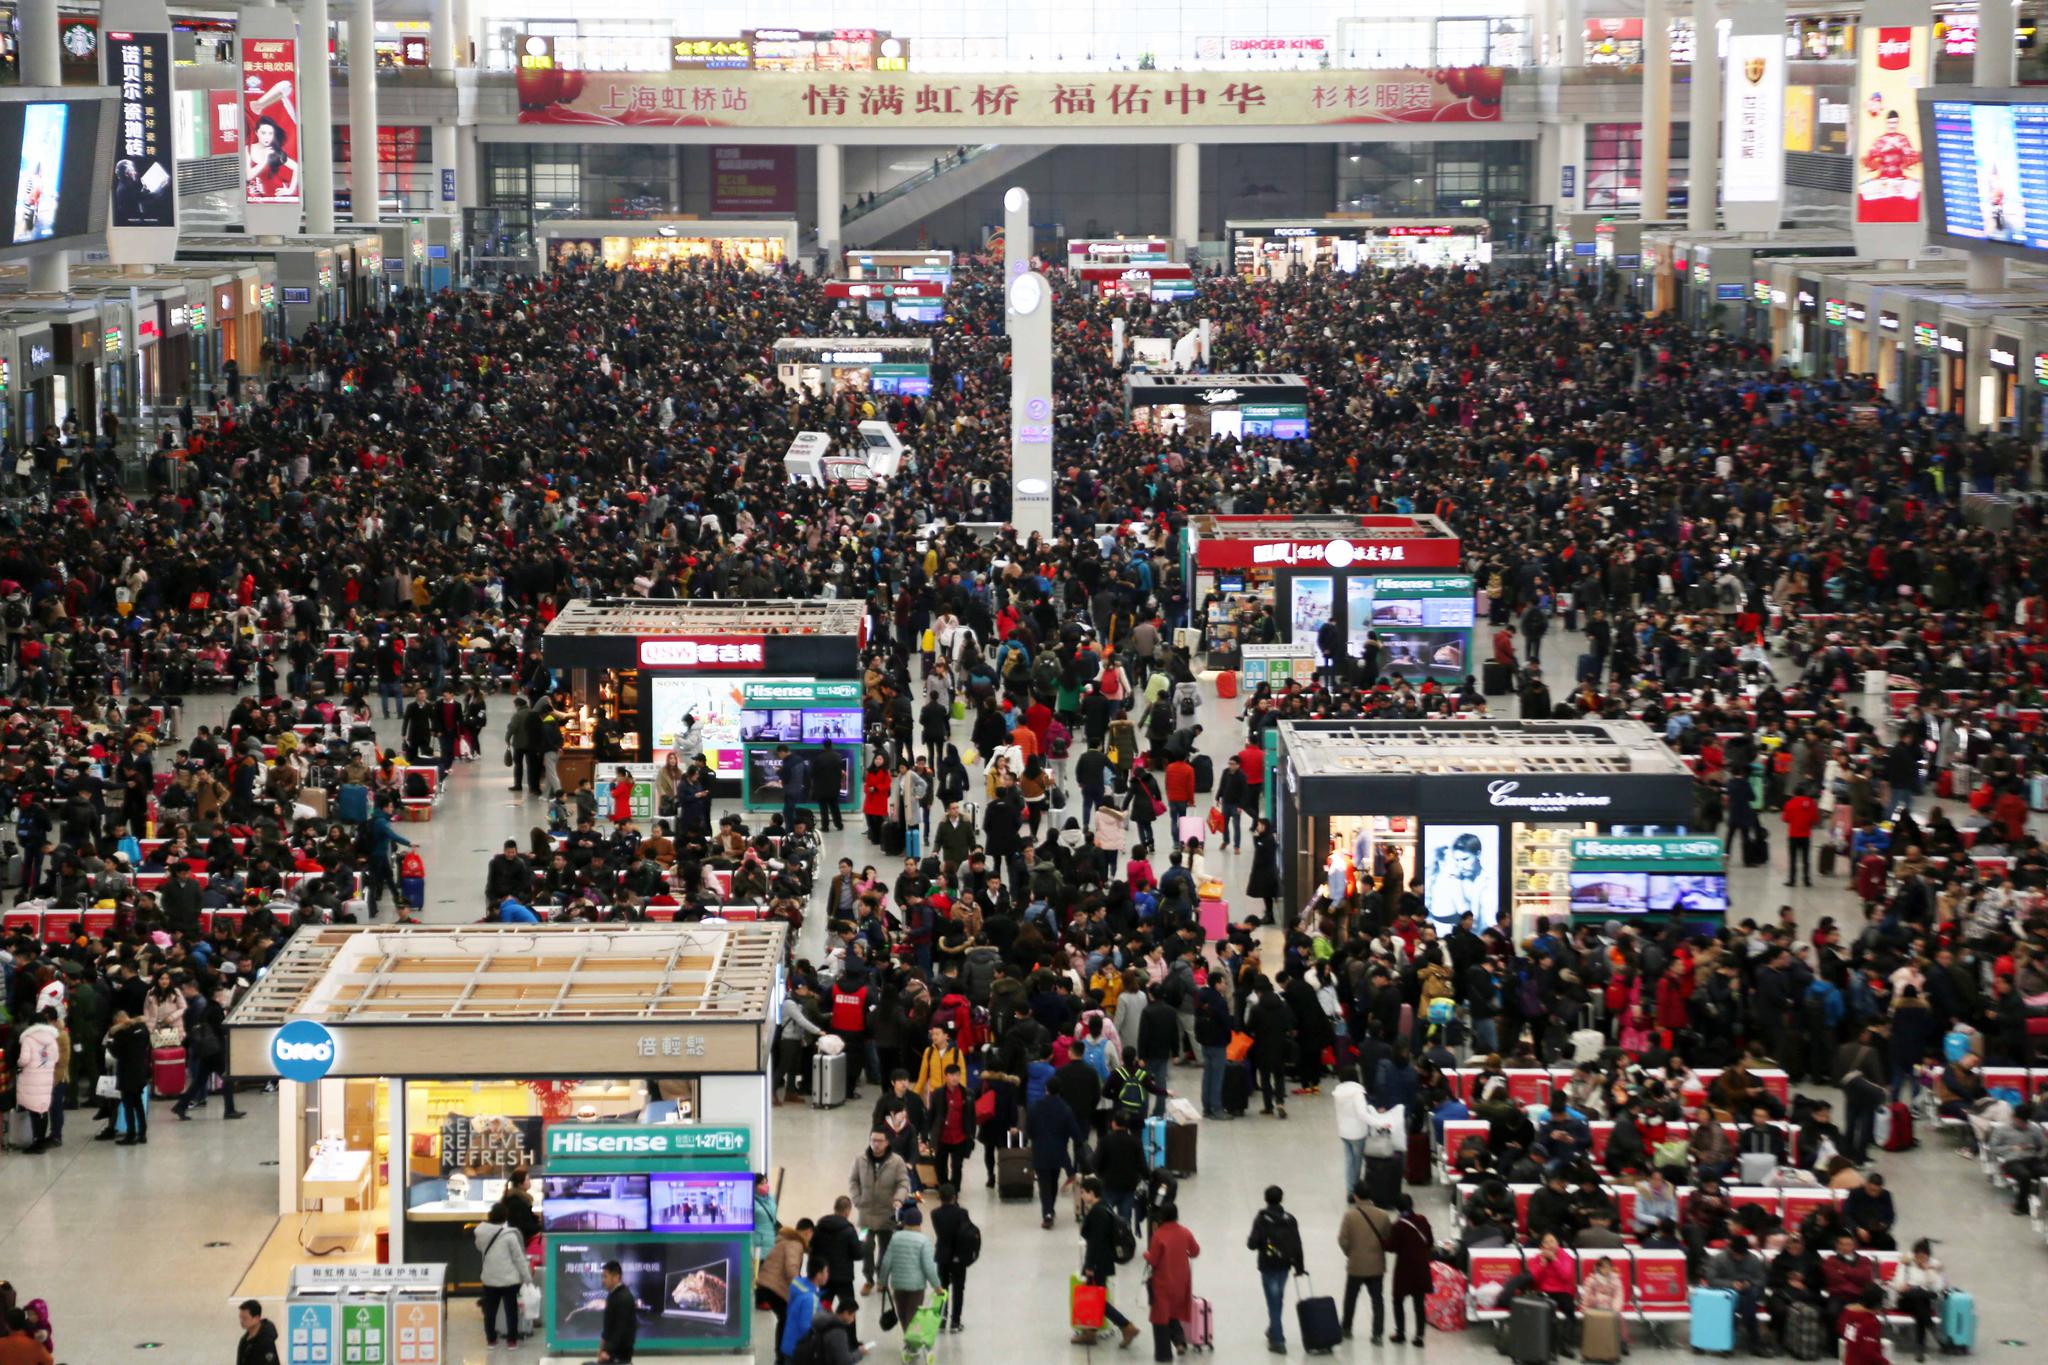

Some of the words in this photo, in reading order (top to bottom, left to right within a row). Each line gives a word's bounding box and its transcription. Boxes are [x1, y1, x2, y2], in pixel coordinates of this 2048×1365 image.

[1230, 39, 1286, 50] BURGER
[1290, 39, 1325, 50] KING
[601, 84, 748, 112] 上海虹桥站
[801, 83, 1019, 116] 情满虹桥
[1048, 82, 1266, 115] 福佑中华
[1311, 81, 1433, 110] 杉杉服装
[745, 684, 813, 697] Hisense
[1575, 841, 1663, 856] Hisense
[276, 1038, 333, 1062] breo
[442, 1133, 526, 1150] RELIEVE
[552, 1132, 668, 1152] Hisense
[442, 1149, 535, 1167] REFRESH
